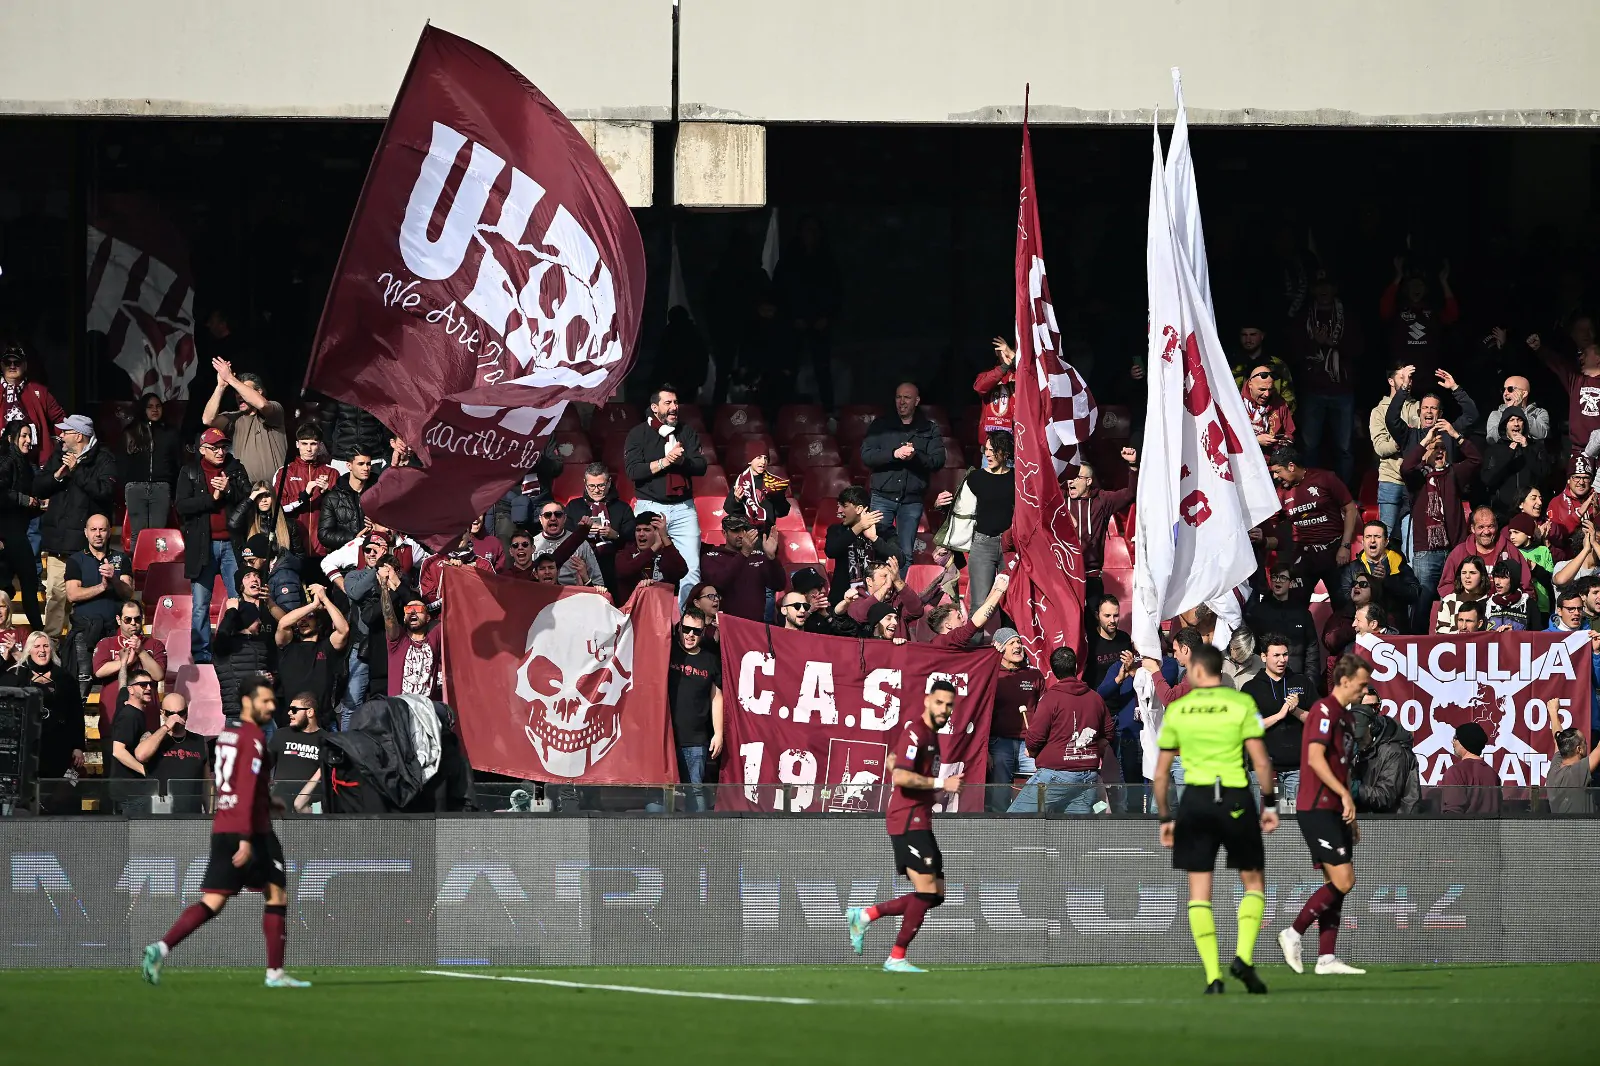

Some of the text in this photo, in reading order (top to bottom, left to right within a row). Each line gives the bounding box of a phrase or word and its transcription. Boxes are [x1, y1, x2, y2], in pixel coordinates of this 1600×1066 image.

[1288, 501, 1317, 516] SPEEDY
[1371, 641, 1577, 682] SICILIA
[1523, 698, 1573, 732] 05
[285, 742, 320, 754] TOMMY
[297, 752, 319, 760] JEANS
